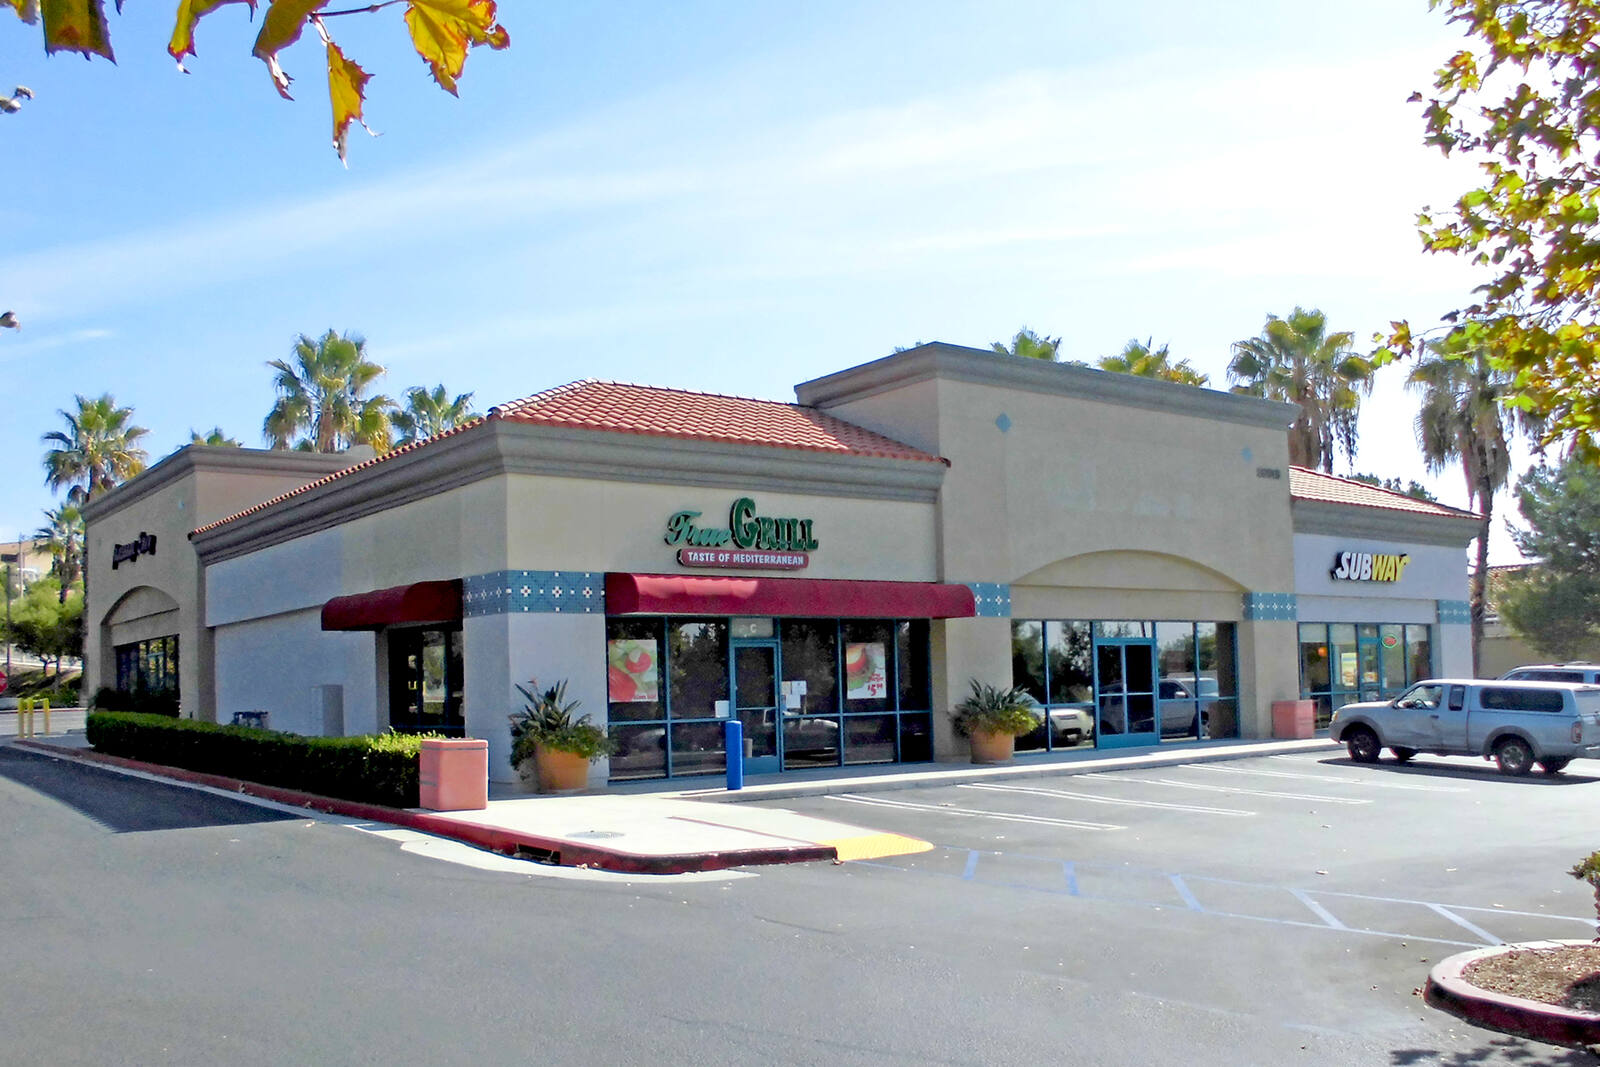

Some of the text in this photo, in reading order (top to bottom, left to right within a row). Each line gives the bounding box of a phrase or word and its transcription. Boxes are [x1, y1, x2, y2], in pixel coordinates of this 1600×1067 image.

[664, 497, 819, 550] True GRILL
[688, 551, 805, 565] TASTE OF MEDITERRANEAN
[1333, 552, 1411, 582] SUBWAY
